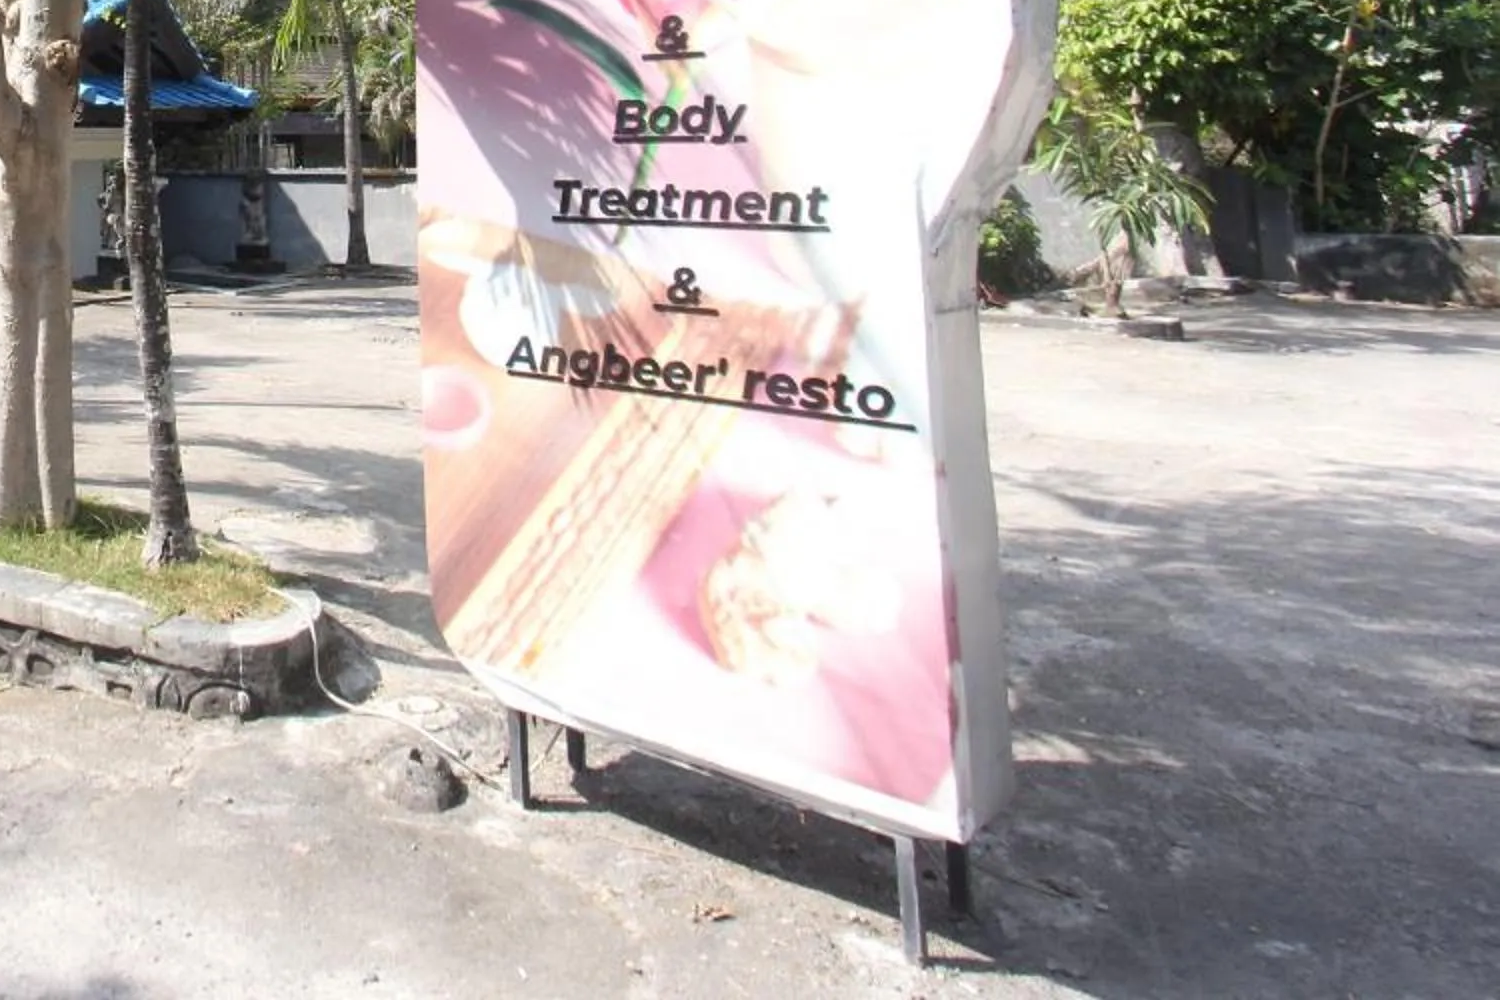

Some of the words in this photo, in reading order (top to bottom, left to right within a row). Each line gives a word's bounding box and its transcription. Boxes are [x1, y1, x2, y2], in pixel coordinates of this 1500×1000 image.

[654, 14, 690, 53] &
[614, 95, 748, 144] Body
[554, 179, 830, 225] Treatment
[666, 267, 700, 305] &
[741, 369, 896, 420] resto
